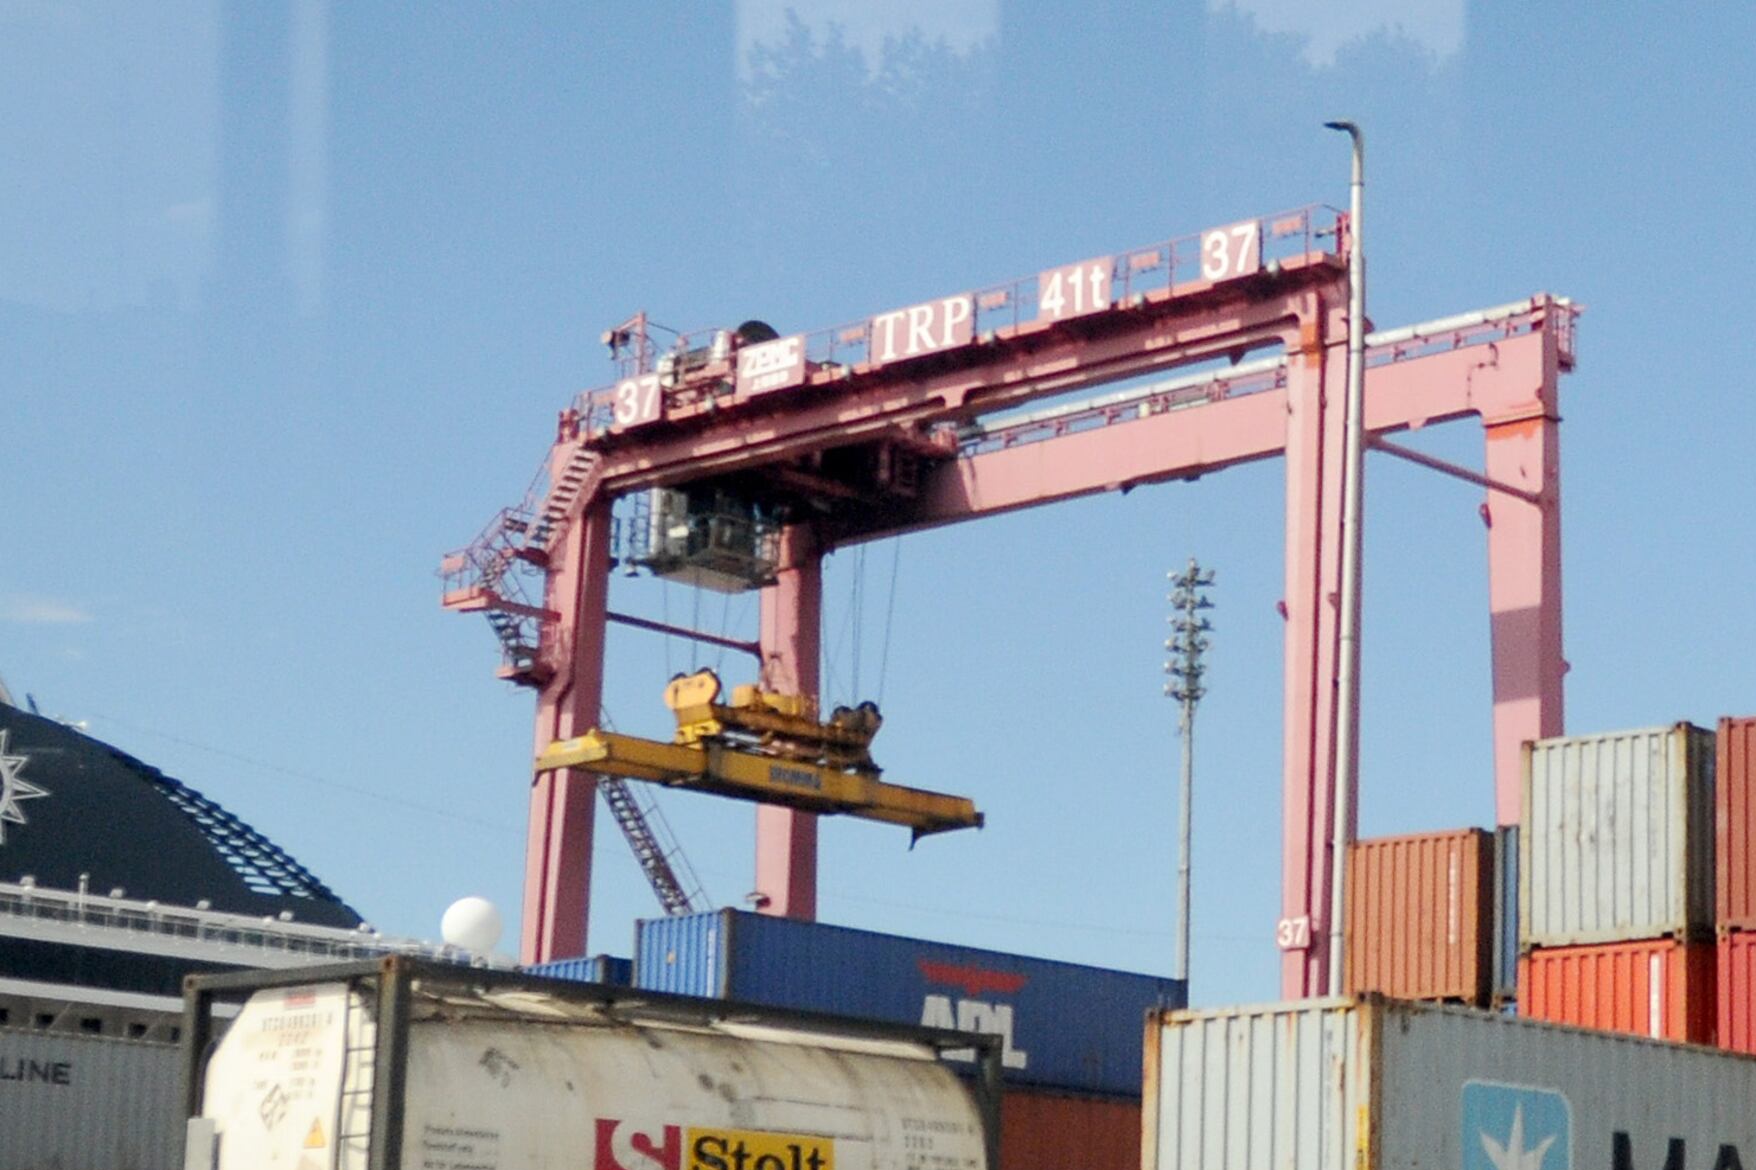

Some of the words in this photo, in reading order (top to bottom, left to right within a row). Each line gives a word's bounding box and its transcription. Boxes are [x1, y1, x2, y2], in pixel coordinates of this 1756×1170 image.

[1203, 225, 1258, 280] 37
[1040, 266, 1106, 317] 41t
[876, 299, 972, 363] TRP
[615, 378, 660, 427] 37
[1276, 916, 1309, 946] 37
